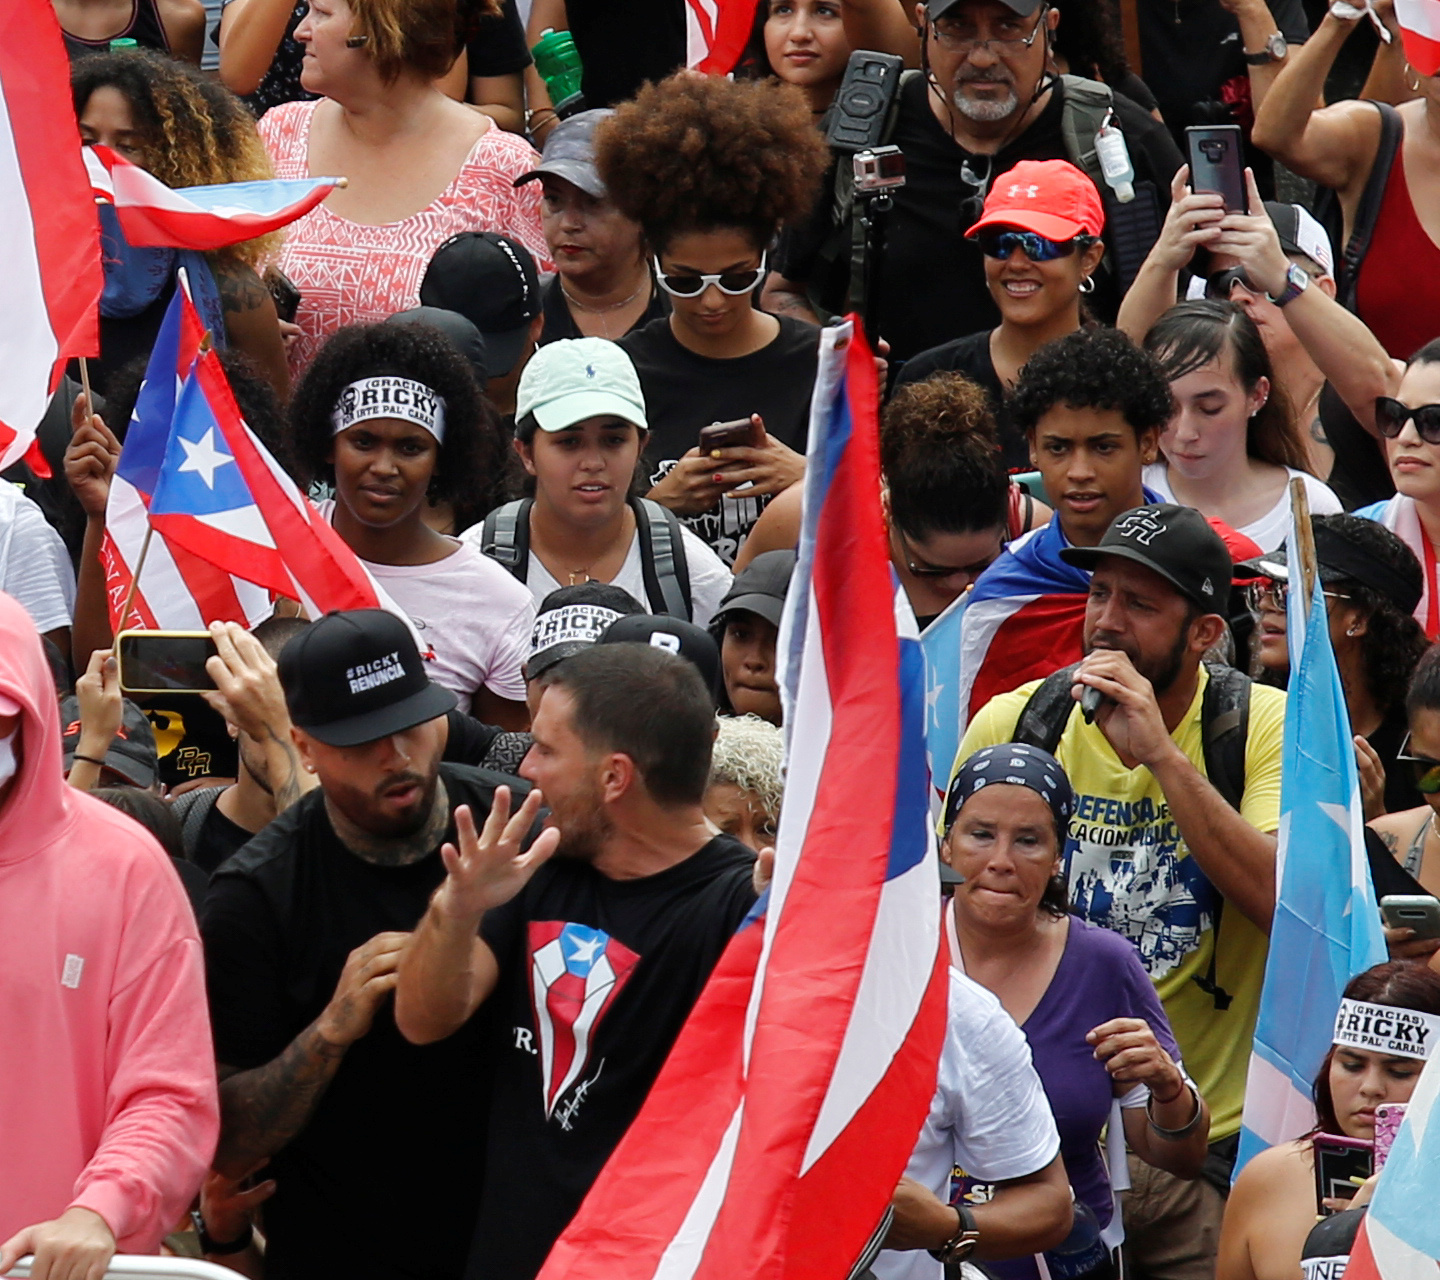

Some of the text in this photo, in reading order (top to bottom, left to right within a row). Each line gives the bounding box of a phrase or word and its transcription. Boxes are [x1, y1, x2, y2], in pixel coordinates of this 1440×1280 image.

[361, 389, 438, 419] RICKY
[346, 651, 400, 679] #RICKY
[349, 661, 407, 695] RENUNCIA
[1348, 1015, 1431, 1044] RICKY
[1353, 1005, 1426, 1028] (GRACIAS)
